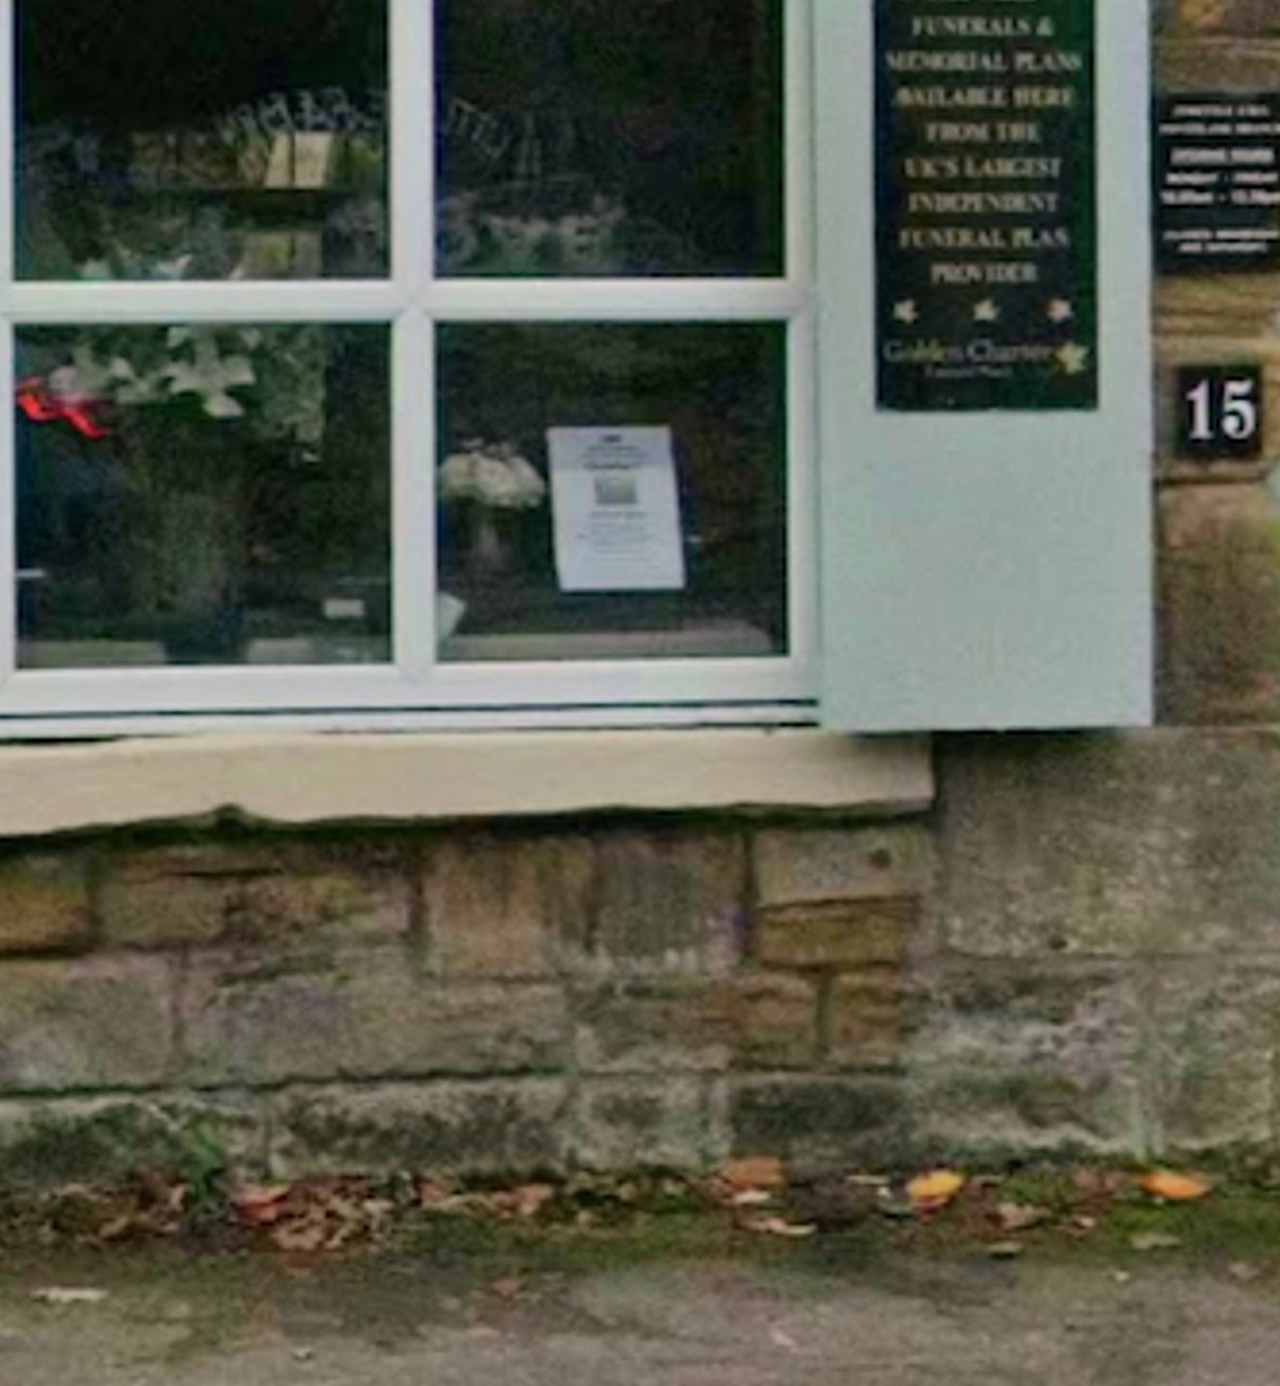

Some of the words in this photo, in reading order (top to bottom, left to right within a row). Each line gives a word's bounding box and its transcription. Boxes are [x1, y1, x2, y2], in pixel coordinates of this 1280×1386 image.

[911, 16, 1031, 37] FUNERALS
[1035, 17, 1055, 37] &
[886, 51, 1008, 72] MEMORIAL
[1014, 52, 1083, 72] PLANS
[894, 86, 1007, 108] AVAILABLE
[1012, 86, 1074, 108] HERE
[925, 122, 990, 144] FROM
[997, 122, 1041, 144] THE
[965, 157, 1062, 178] LARGEST
[907, 192, 1059, 214] INDEPENDENT
[898, 227, 1007, 248] FUNERAL
[1010, 227, 1070, 248] PLAN
[931, 262, 1039, 284] PROVIDER
[882, 339, 964, 363] Golden
[1185, 378, 1256, 440] 15
